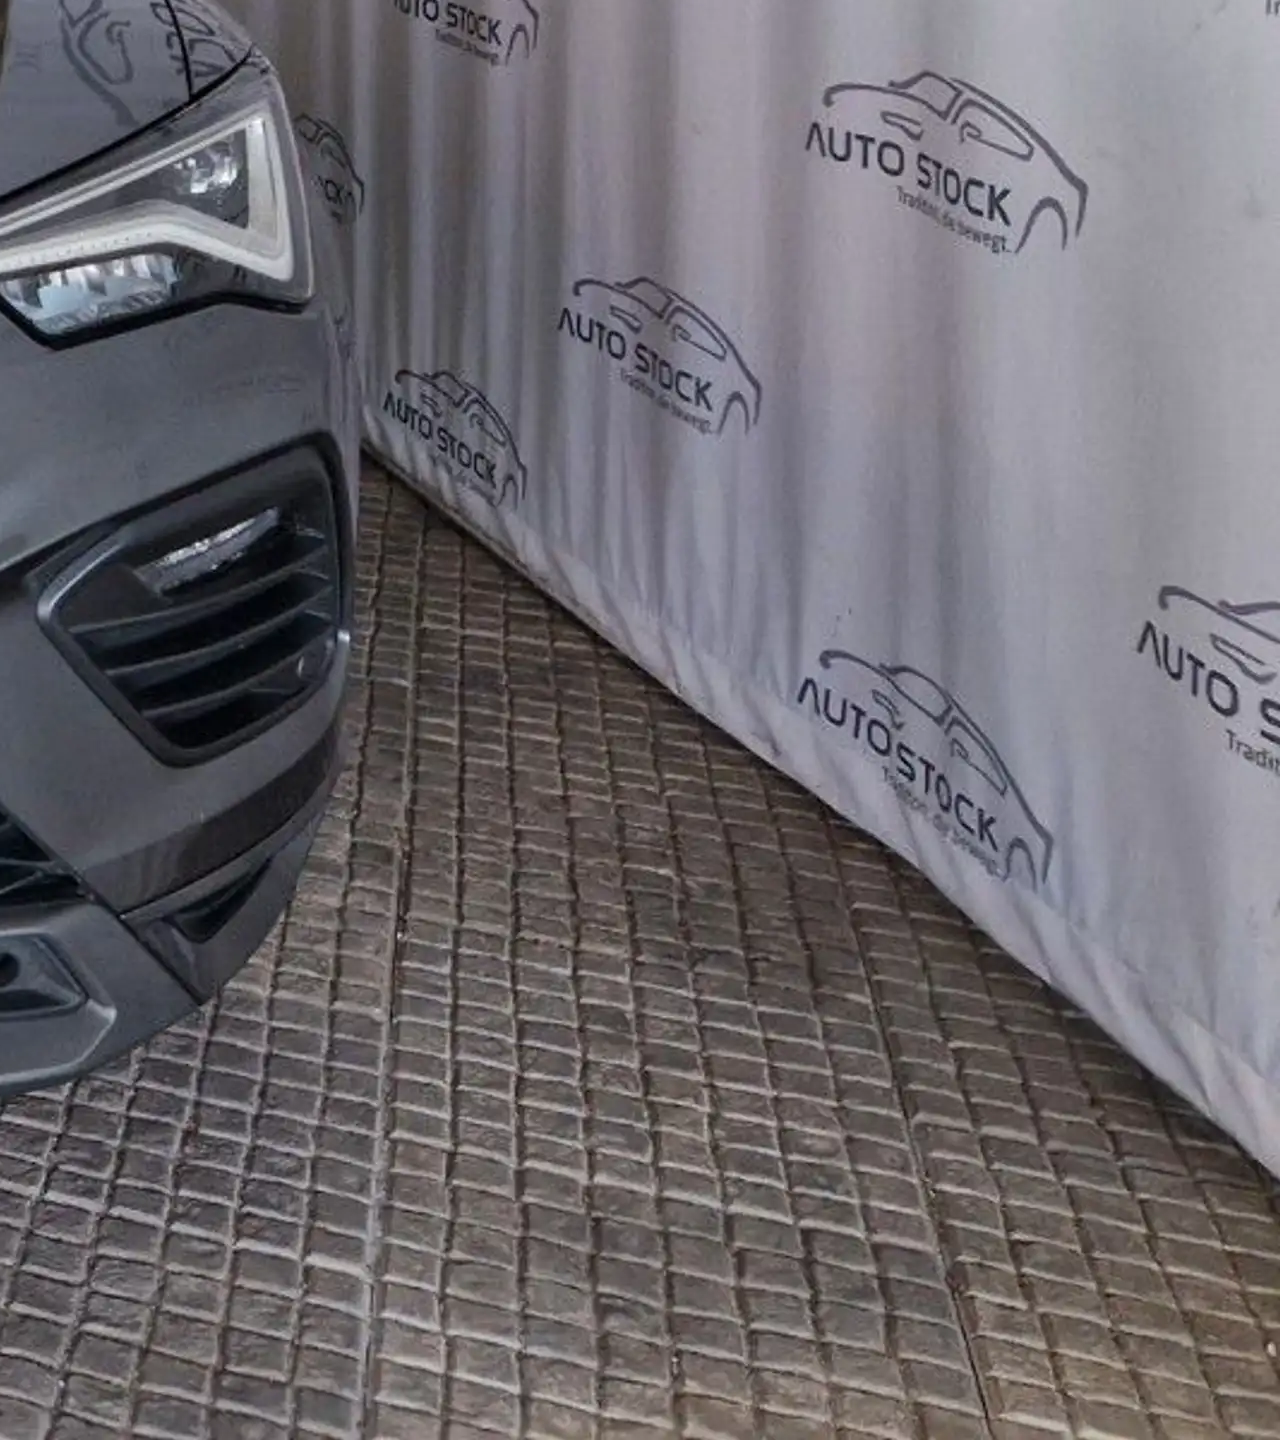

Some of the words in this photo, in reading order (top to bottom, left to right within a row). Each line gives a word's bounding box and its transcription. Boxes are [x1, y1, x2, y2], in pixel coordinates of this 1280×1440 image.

[446, 2, 501, 46] STOCK
[805, 122, 905, 176] AUTO
[916, 153, 1011, 227] STOCK
[557, 307, 627, 360] AUTO
[634, 342, 713, 411] STOCK
[383, 392, 433, 440] AUTO
[437, 427, 497, 489] STOCK
[1136, 620, 1239, 717] AUTO
[797, 677, 892, 757] AUTO
[896, 741, 999, 853] STOCK
